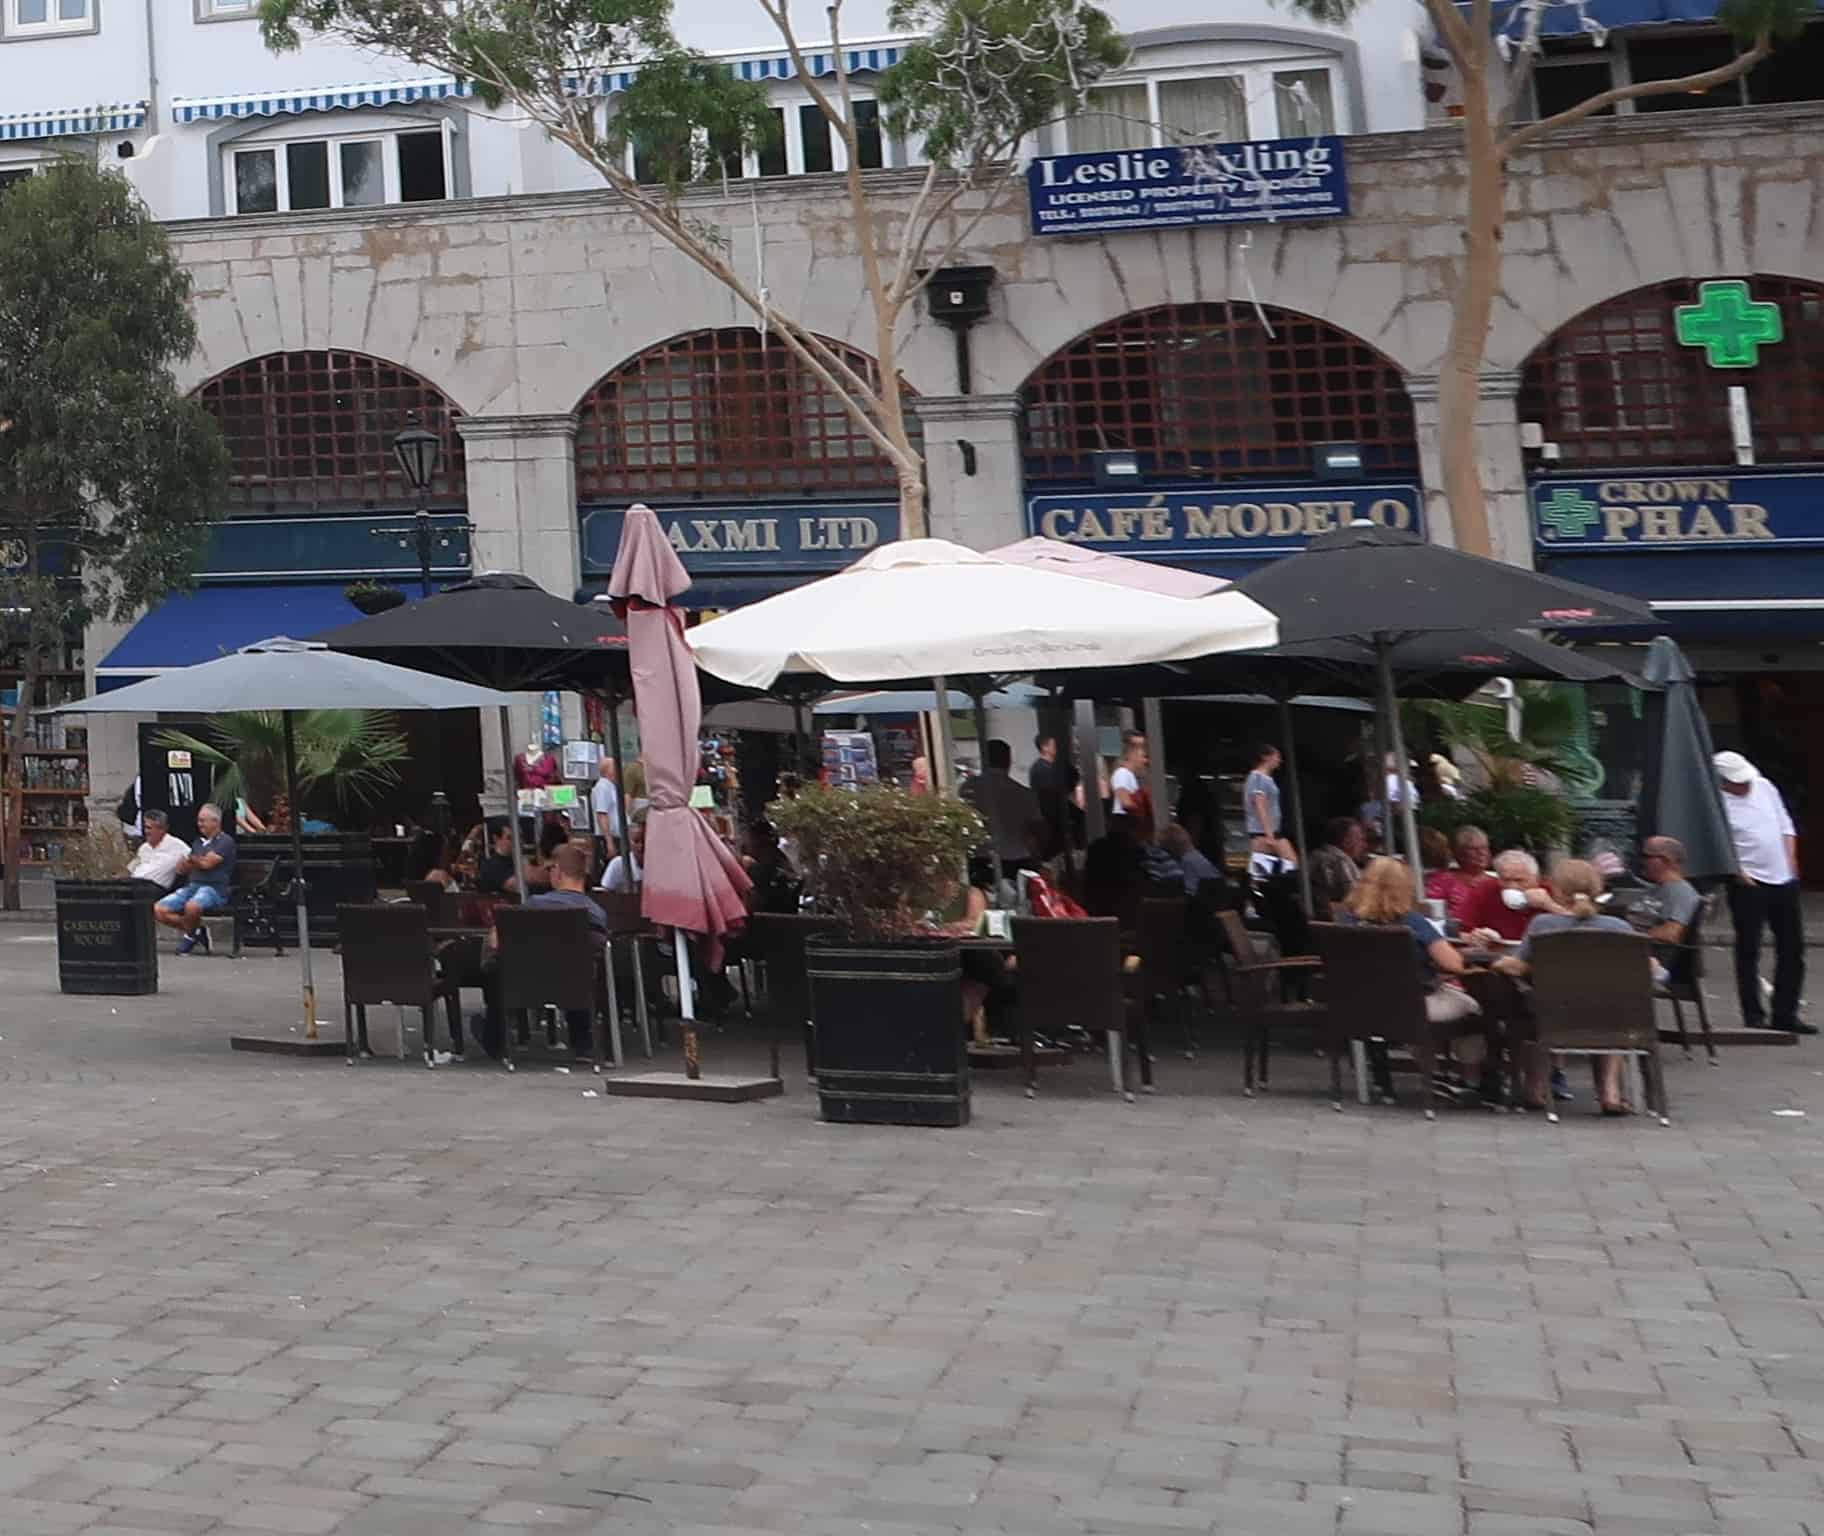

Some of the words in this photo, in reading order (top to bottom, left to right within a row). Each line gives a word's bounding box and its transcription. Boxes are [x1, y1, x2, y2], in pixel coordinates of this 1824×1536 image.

[1038, 154, 1171, 187] Leslie
[1181, 145, 1333, 177] Ayling
[1048, 189, 1135, 205] LICENSED
[1139, 182, 1239, 199] PROPERTY
[1599, 479, 1731, 504] CROWN
[667, 518, 782, 552] AXMI
[799, 516, 880, 550] LTD
[1041, 495, 1174, 541] CAFÉ
[1181, 499, 1411, 539] MODELO
[1599, 504, 1777, 542] PHAR
